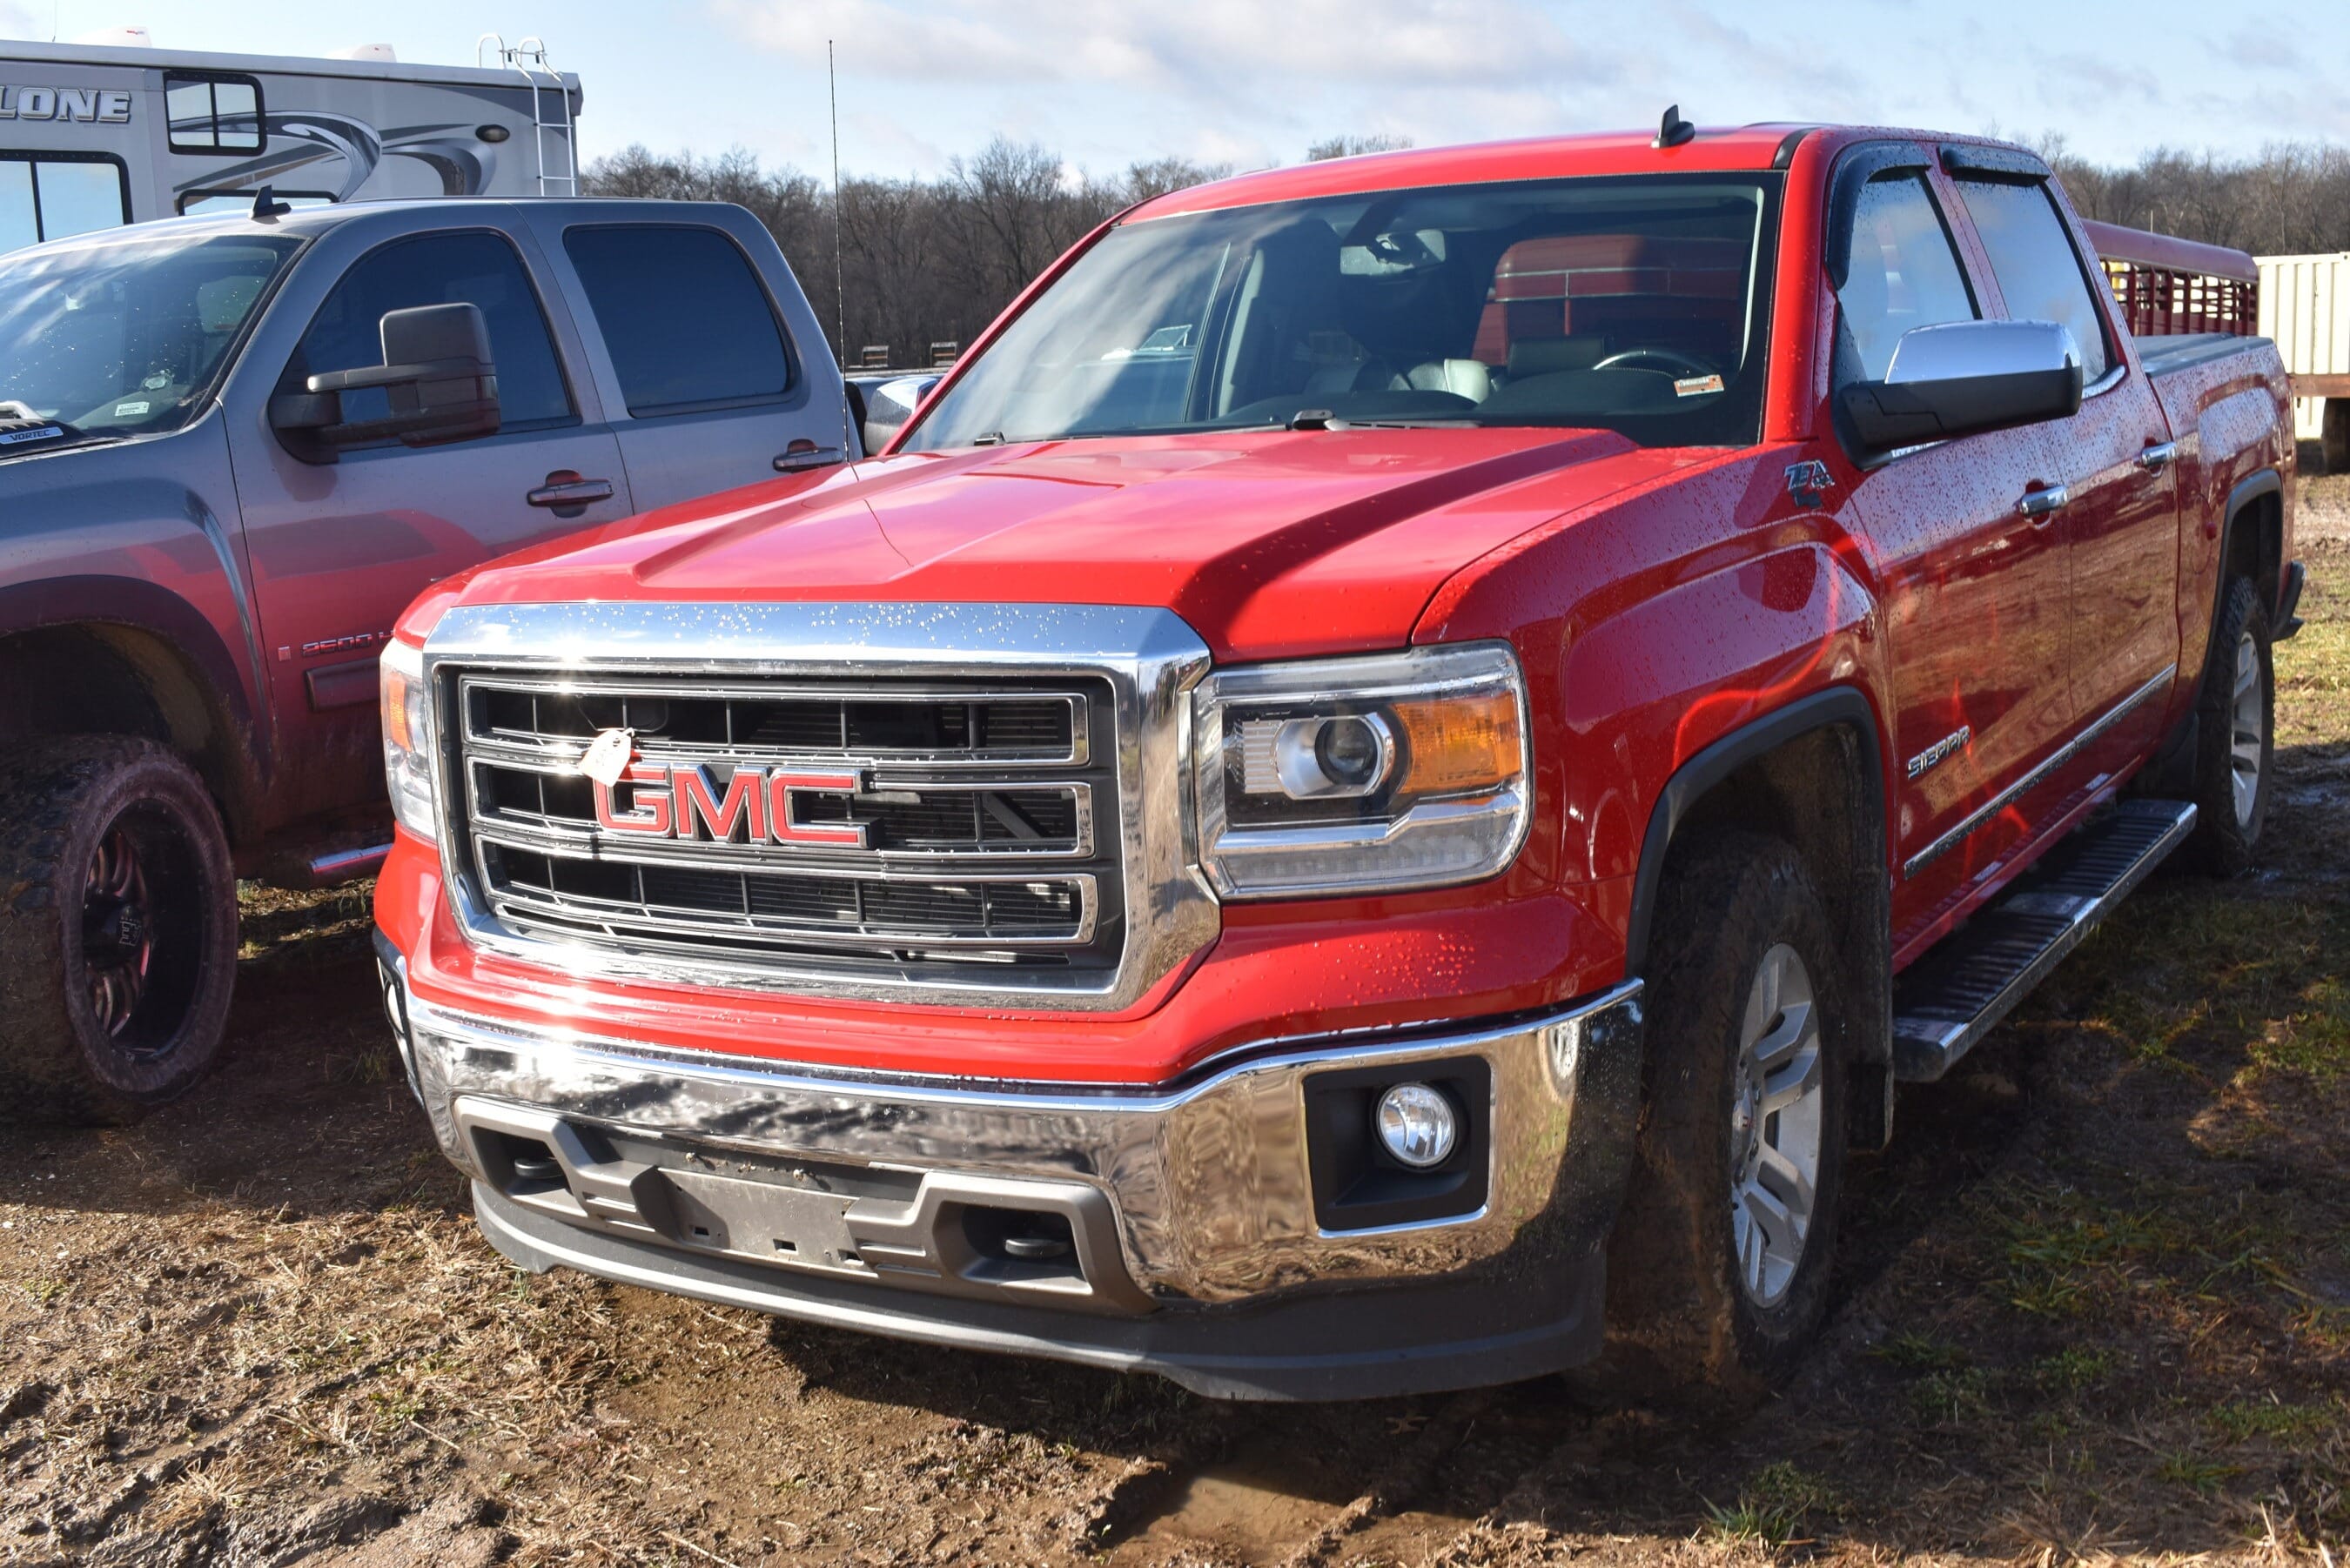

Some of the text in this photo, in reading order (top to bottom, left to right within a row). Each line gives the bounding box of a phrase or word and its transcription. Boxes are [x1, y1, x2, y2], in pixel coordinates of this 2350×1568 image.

[9, 429, 50, 442] VORTEC
[1908, 724, 1970, 781] SIERRA
[593, 761, 870, 850] GMC
